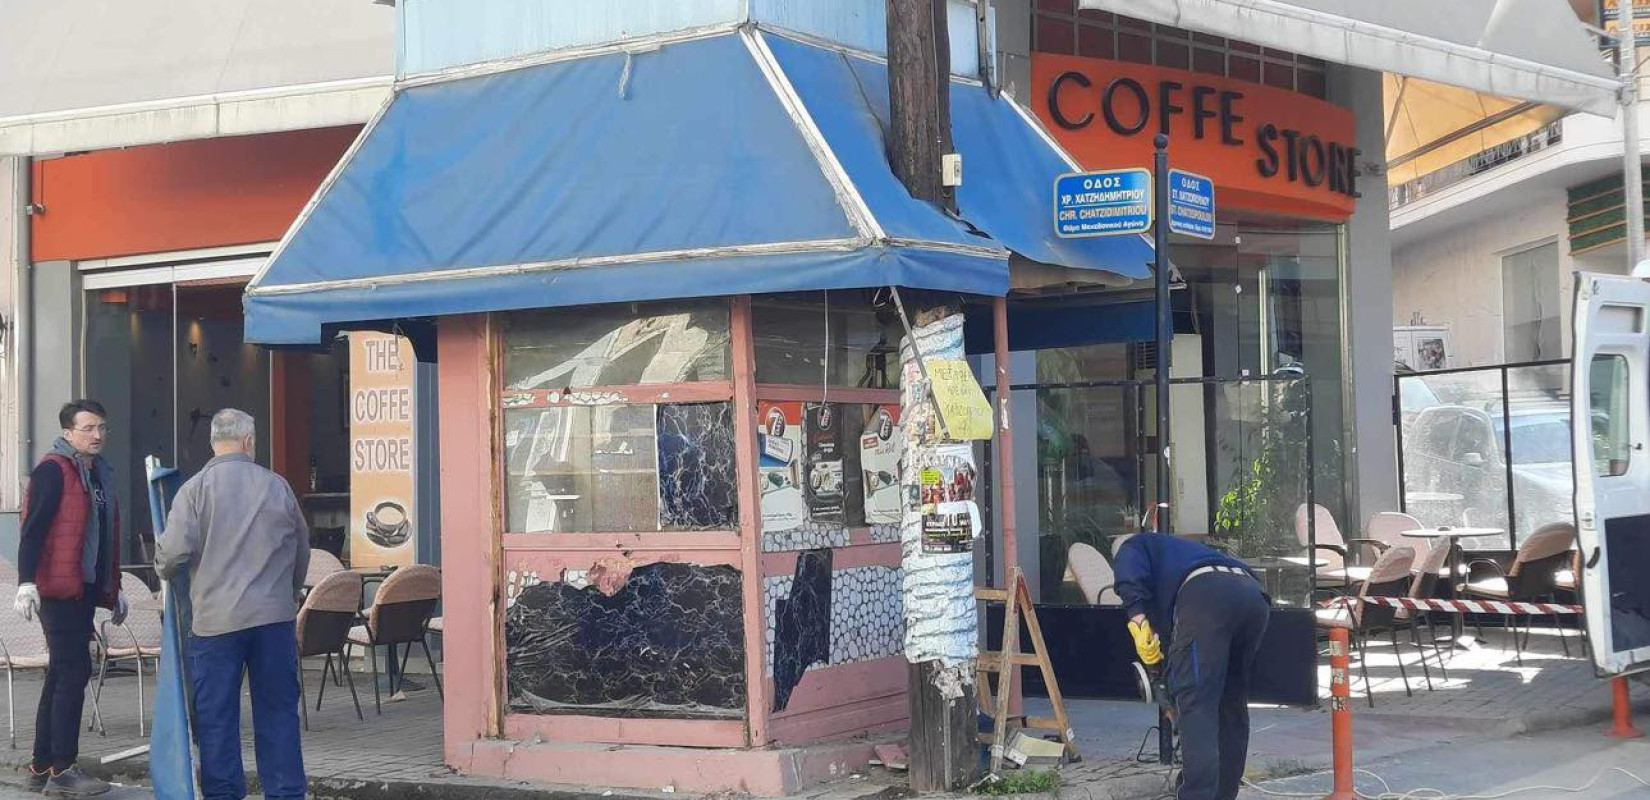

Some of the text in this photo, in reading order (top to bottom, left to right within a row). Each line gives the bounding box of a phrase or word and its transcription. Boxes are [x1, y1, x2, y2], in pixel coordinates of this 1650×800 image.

[1049, 71, 1246, 146] COFFE
[1256, 123, 1362, 198] STORE
[1061, 188, 1145, 205] ΧΡ. ΧΑΤΖΗΔΗΜΗΤΡΙΟΥ
[1084, 177, 1121, 190] ΟΔΟΣ
[1059, 209, 1077, 221] CHR.
[365, 339, 399, 371] THE
[354, 388, 410, 421] COFFE
[354, 438, 410, 471] STORE
